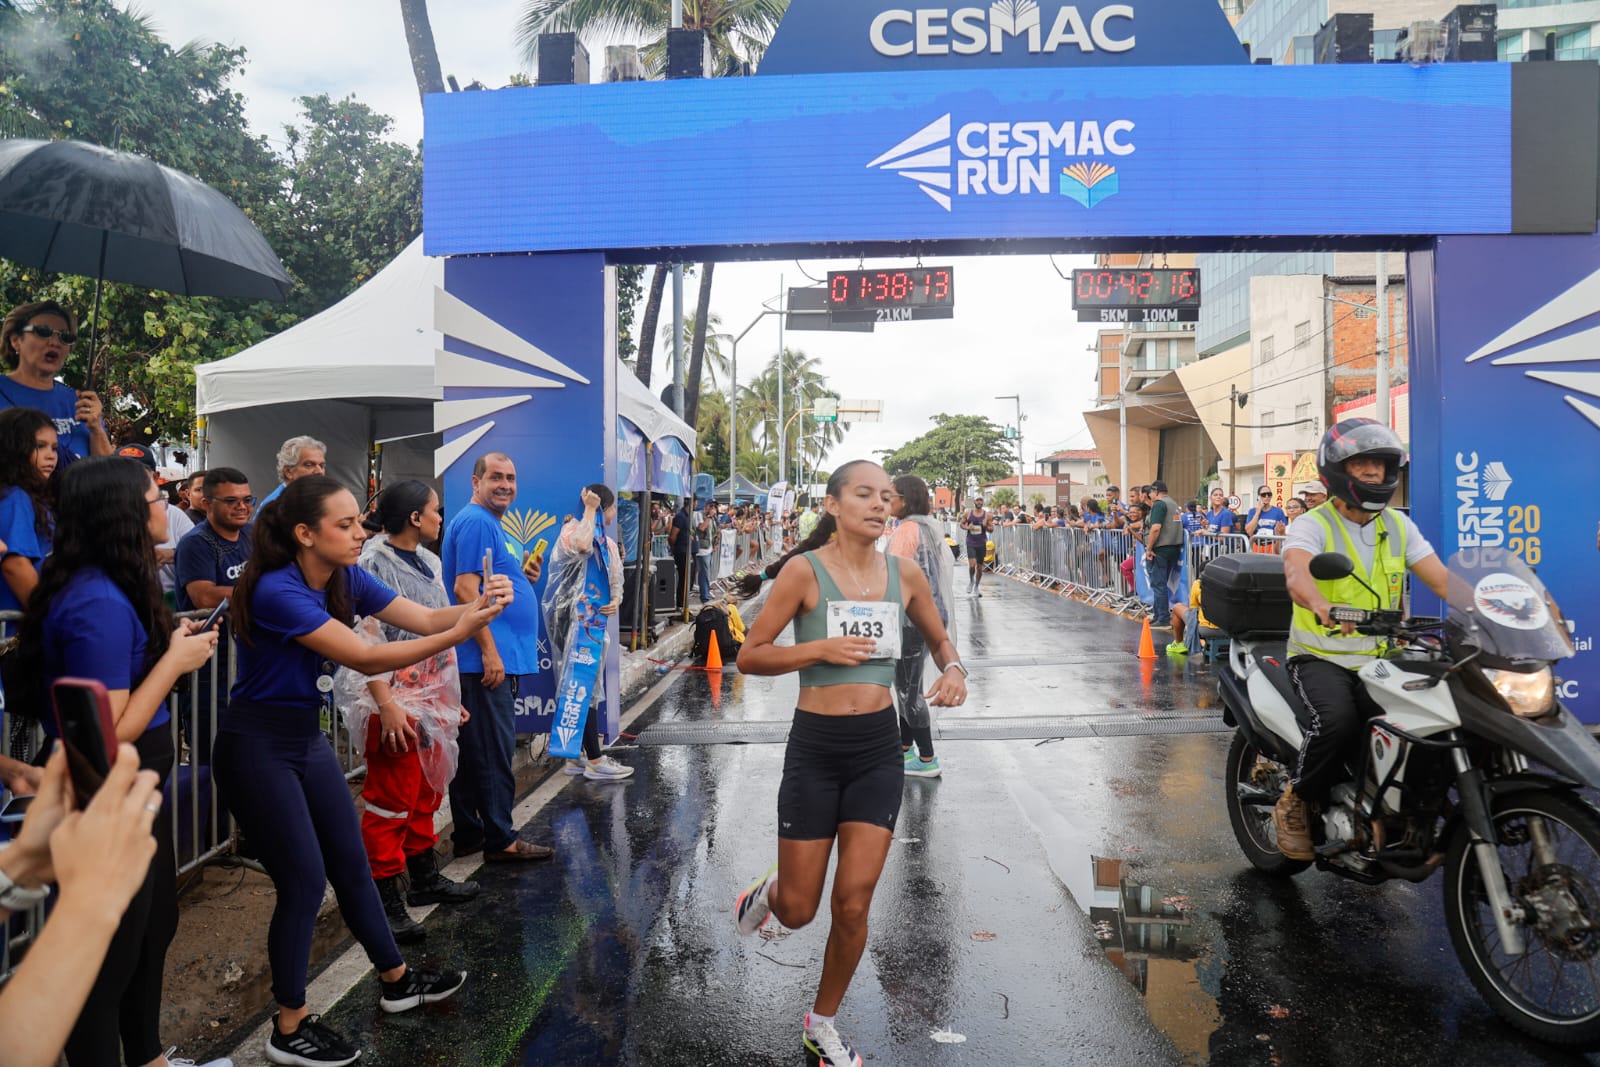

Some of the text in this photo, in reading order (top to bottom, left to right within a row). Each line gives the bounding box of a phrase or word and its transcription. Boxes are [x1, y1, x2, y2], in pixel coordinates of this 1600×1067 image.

[869, 3, 1136, 56] CESMAC
[957, 119, 1136, 158] CESMAC
[957, 157, 1050, 195] RUN
[831, 271, 949, 302] 01:38:13
[1077, 271, 1195, 298] 00:42:16
[876, 307, 913, 321] 21KM
[1100, 308, 1178, 322] 5KM 10KM
[1455, 451, 1480, 569] CESMAC
[1507, 504, 1541, 534] 20
[1508, 536, 1542, 565] 26
[840, 621, 883, 639] 1433
